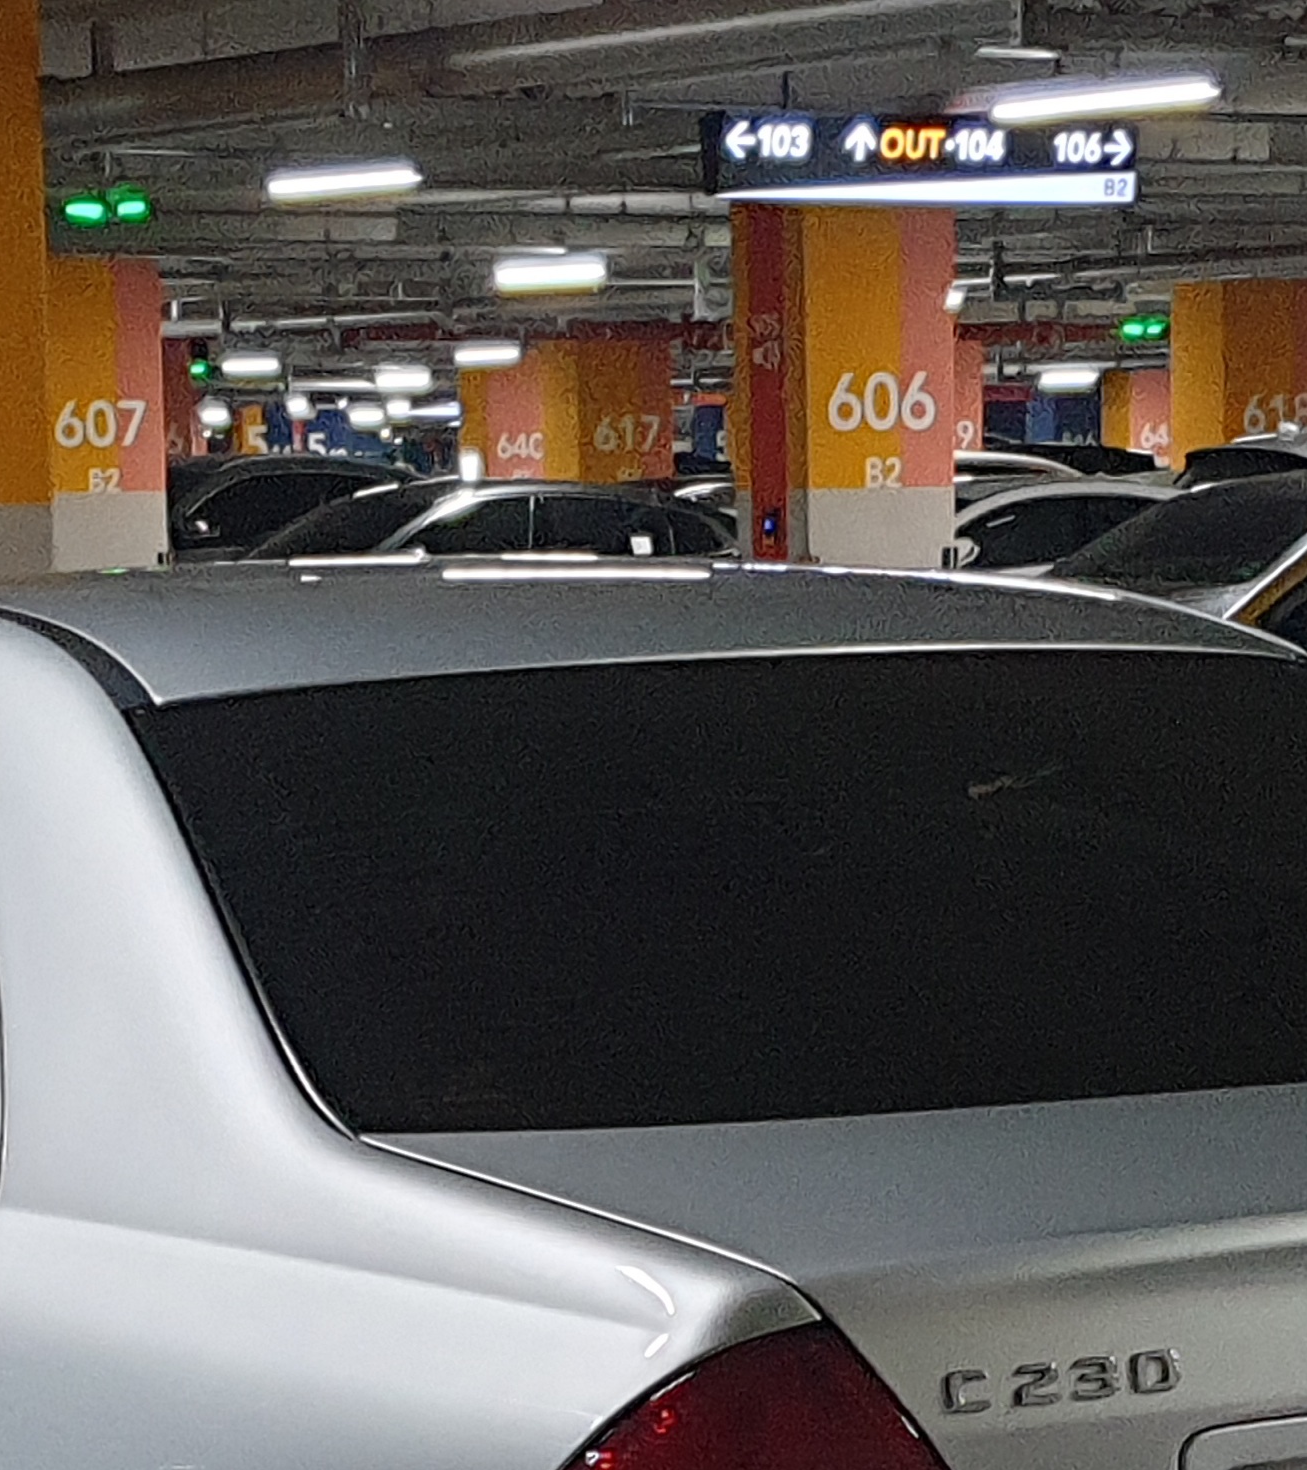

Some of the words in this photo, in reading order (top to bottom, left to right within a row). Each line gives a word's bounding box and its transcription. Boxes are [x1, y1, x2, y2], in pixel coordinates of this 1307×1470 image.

[757, 123, 811, 158] 103
[880, 129, 946, 161] OUT
[1054, 131, 1100, 162] 106
[1104, 178, 1128, 197] B2
[828, 371, 936, 432] 606
[54, 400, 146, 448] 607
[595, 414, 661, 452] 617
[1140, 422, 1170, 449] 64
[865, 456, 902, 488] B2
[941, 1368, 992, 1414] C
[1008, 1348, 1183, 1408] 230
